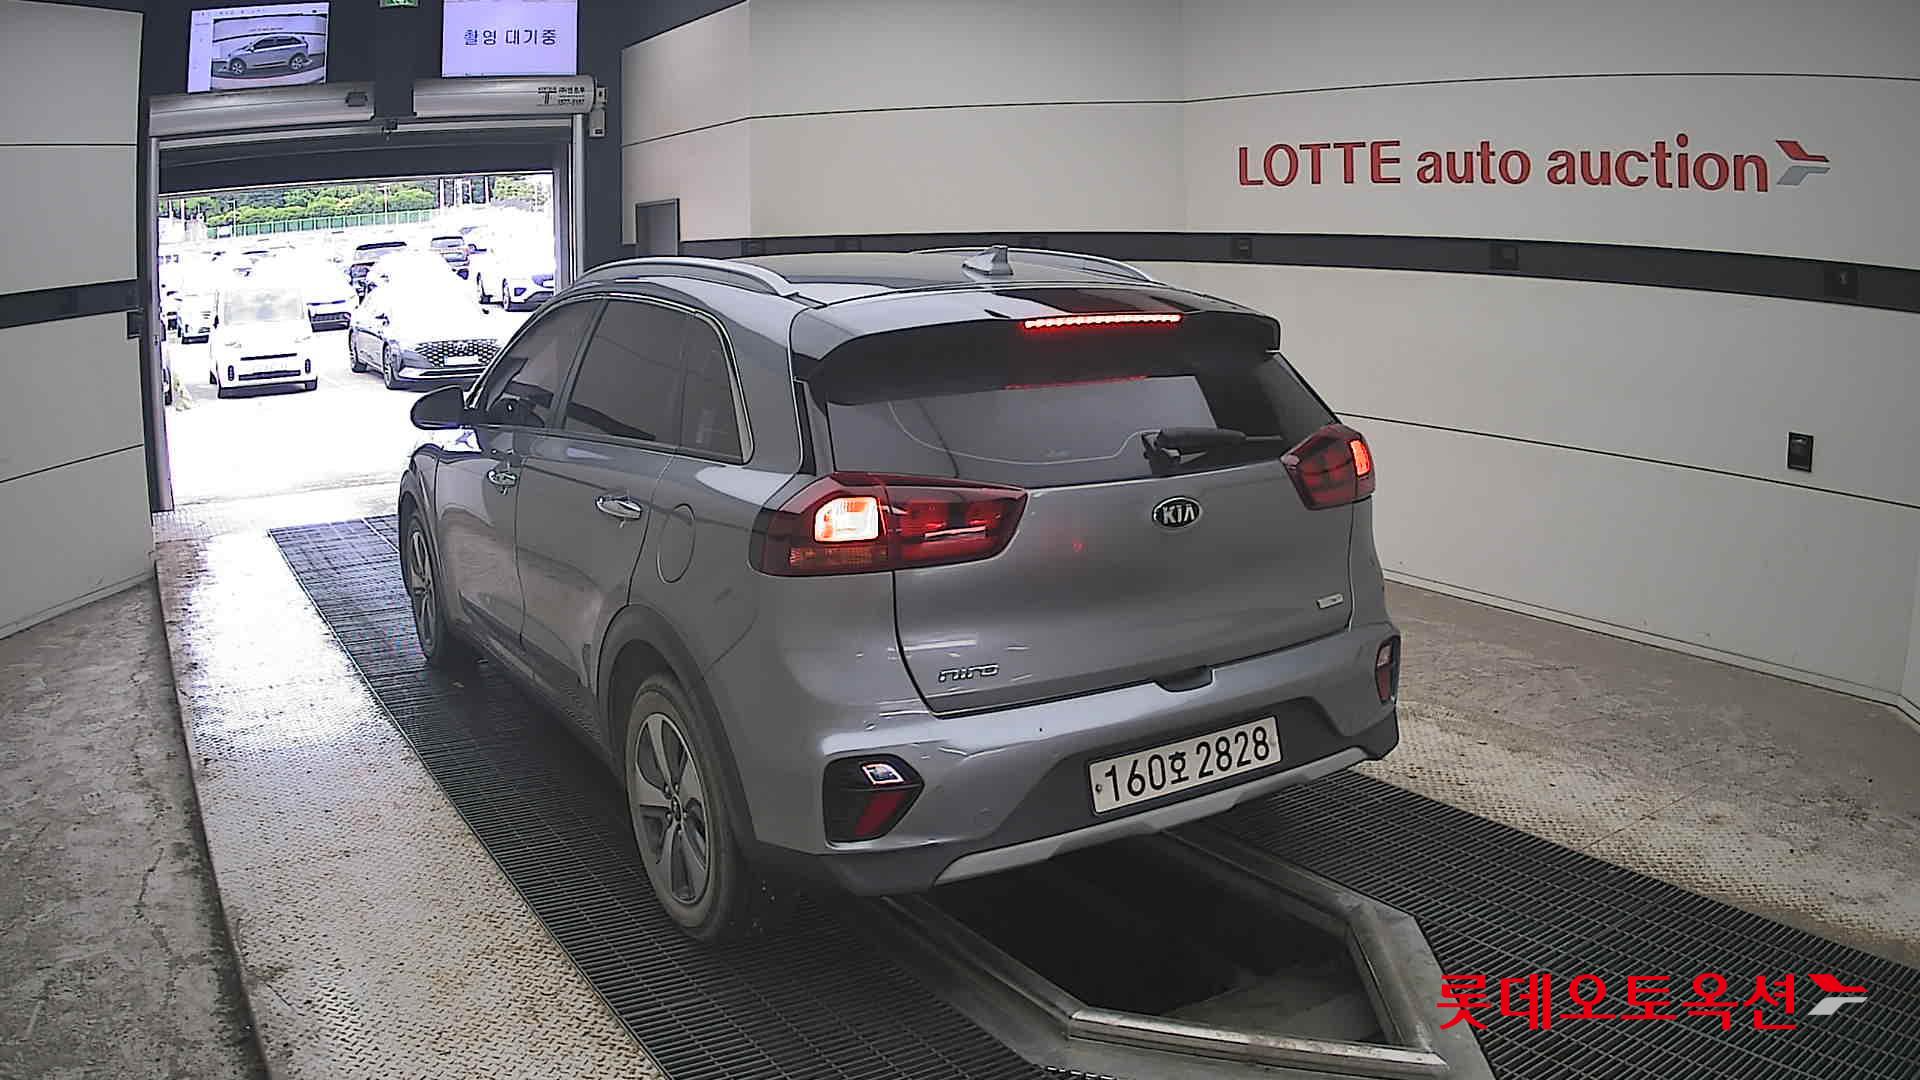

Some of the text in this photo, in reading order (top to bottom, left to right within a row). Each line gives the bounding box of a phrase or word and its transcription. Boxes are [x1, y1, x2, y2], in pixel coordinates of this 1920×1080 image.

[505, 29, 557, 46] 대기중
[1238, 134, 1769, 193] LOTTE auto auction
[1162, 503, 1195, 524] KIA
[1196, 726, 1270, 778] 2828
